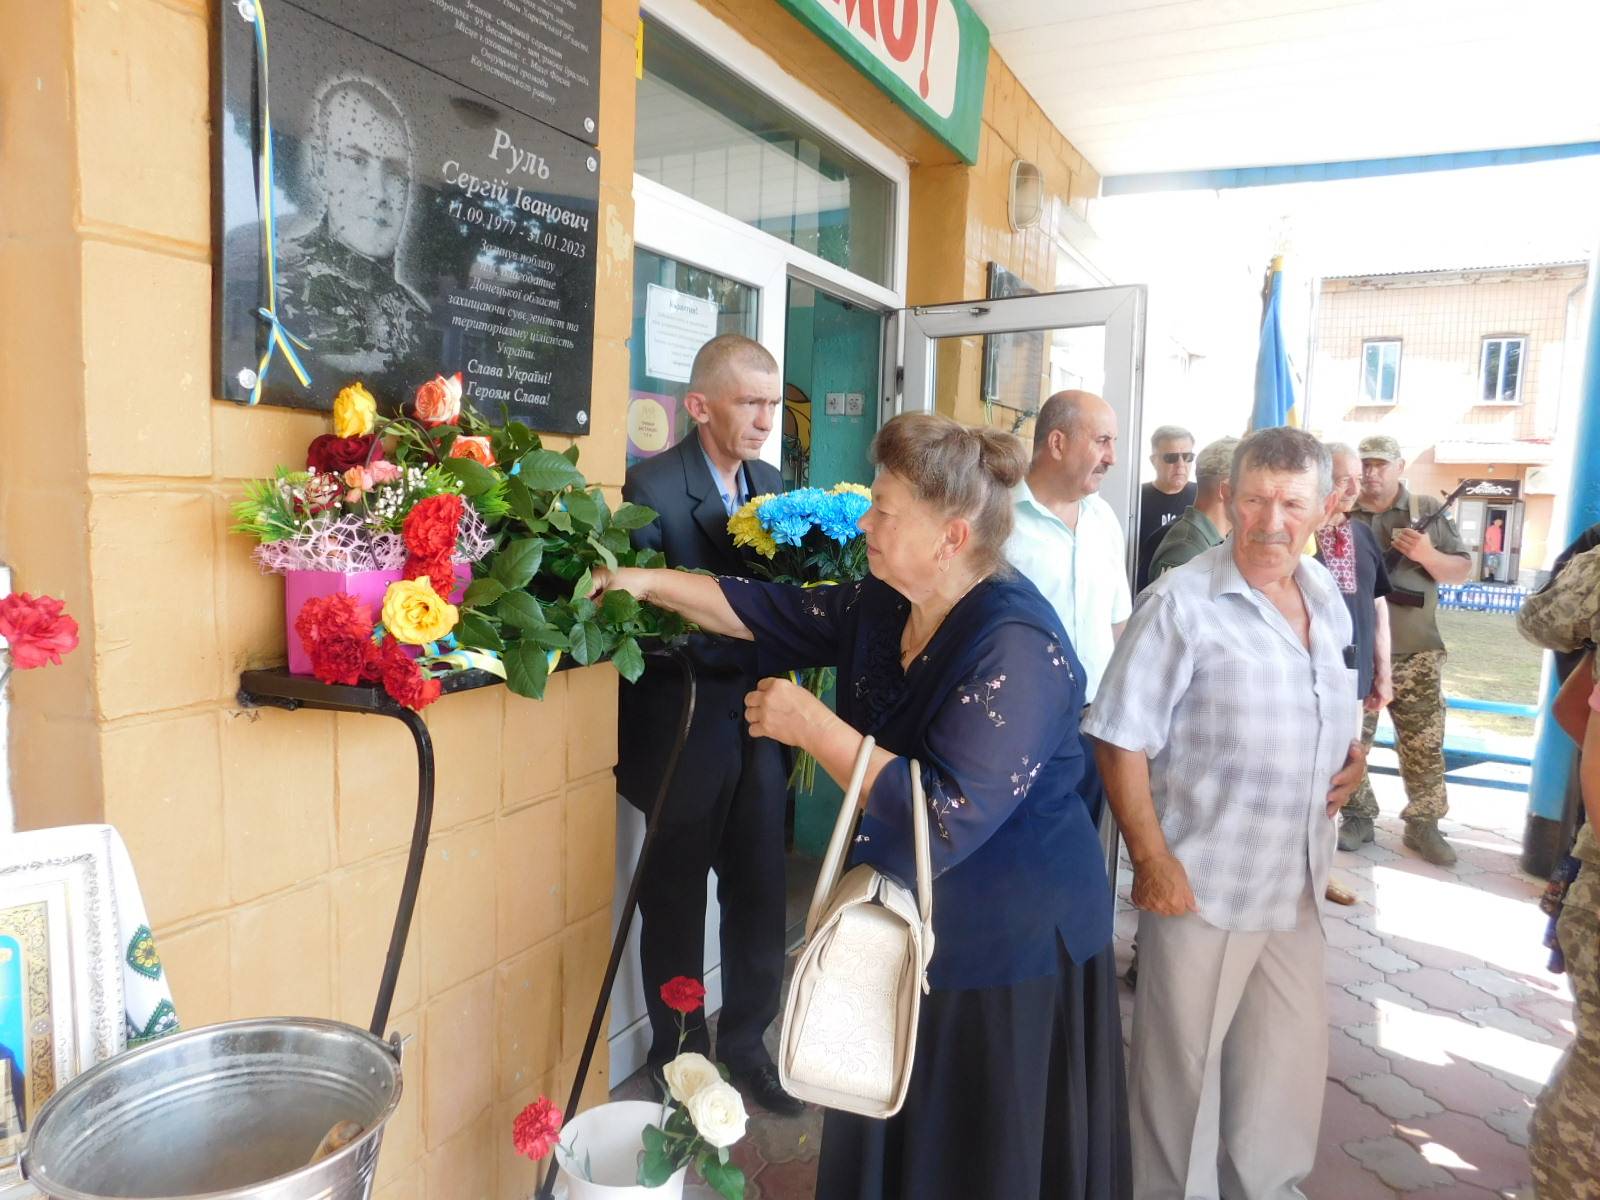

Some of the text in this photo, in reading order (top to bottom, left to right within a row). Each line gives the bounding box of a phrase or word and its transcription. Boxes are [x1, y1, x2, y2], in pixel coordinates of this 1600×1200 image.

[474, 17, 484, 28] 95
[488, 127, 550, 180] Руль
[442, 160, 589, 232] Сергій Іванович
[449, 200, 517, 235] 11.09.1977
[527, 224, 586, 259] 31.01.2023
[470, 276, 523, 301] Донецької
[447, 294, 579, 332] захищаючи суверенітет та
[452, 315, 575, 349] територіальну цілісність
[467, 358, 552, 385] Слава Україні!
[467, 381, 551, 406] Героям Слава!
